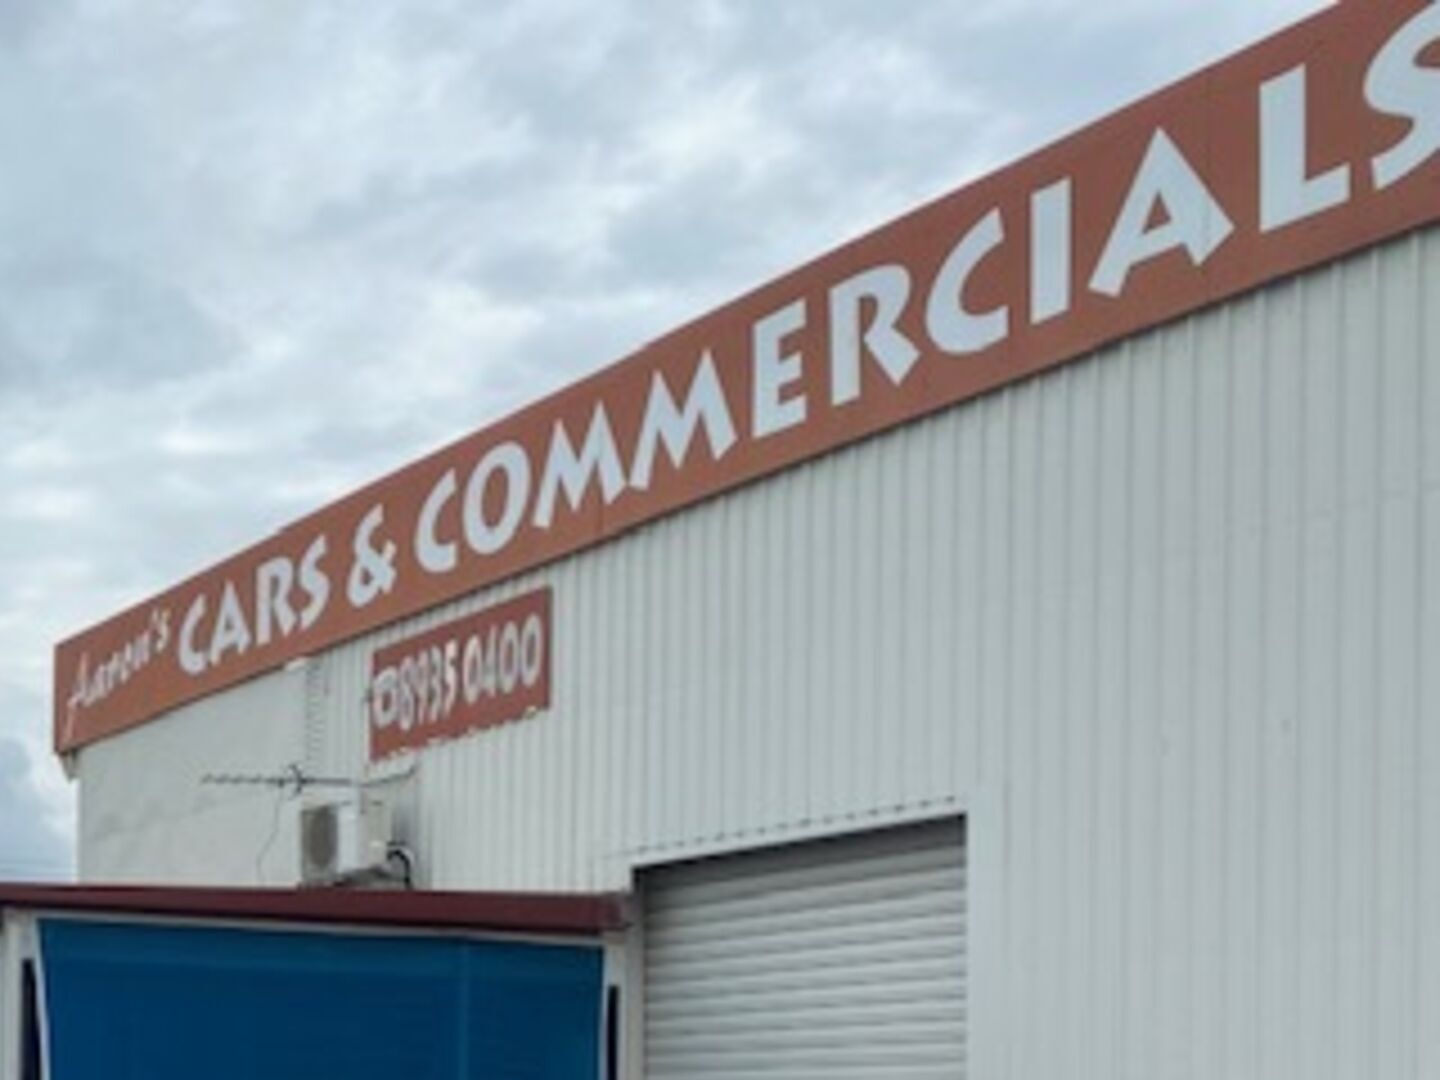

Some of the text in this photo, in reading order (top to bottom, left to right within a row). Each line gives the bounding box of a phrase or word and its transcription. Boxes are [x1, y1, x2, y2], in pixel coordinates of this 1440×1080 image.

[179, 533, 330, 675] CARS
[347, 503, 396, 609] &
[415, 2, 1440, 573] COMMERCIALS
[463, 613, 542, 706] 0400
